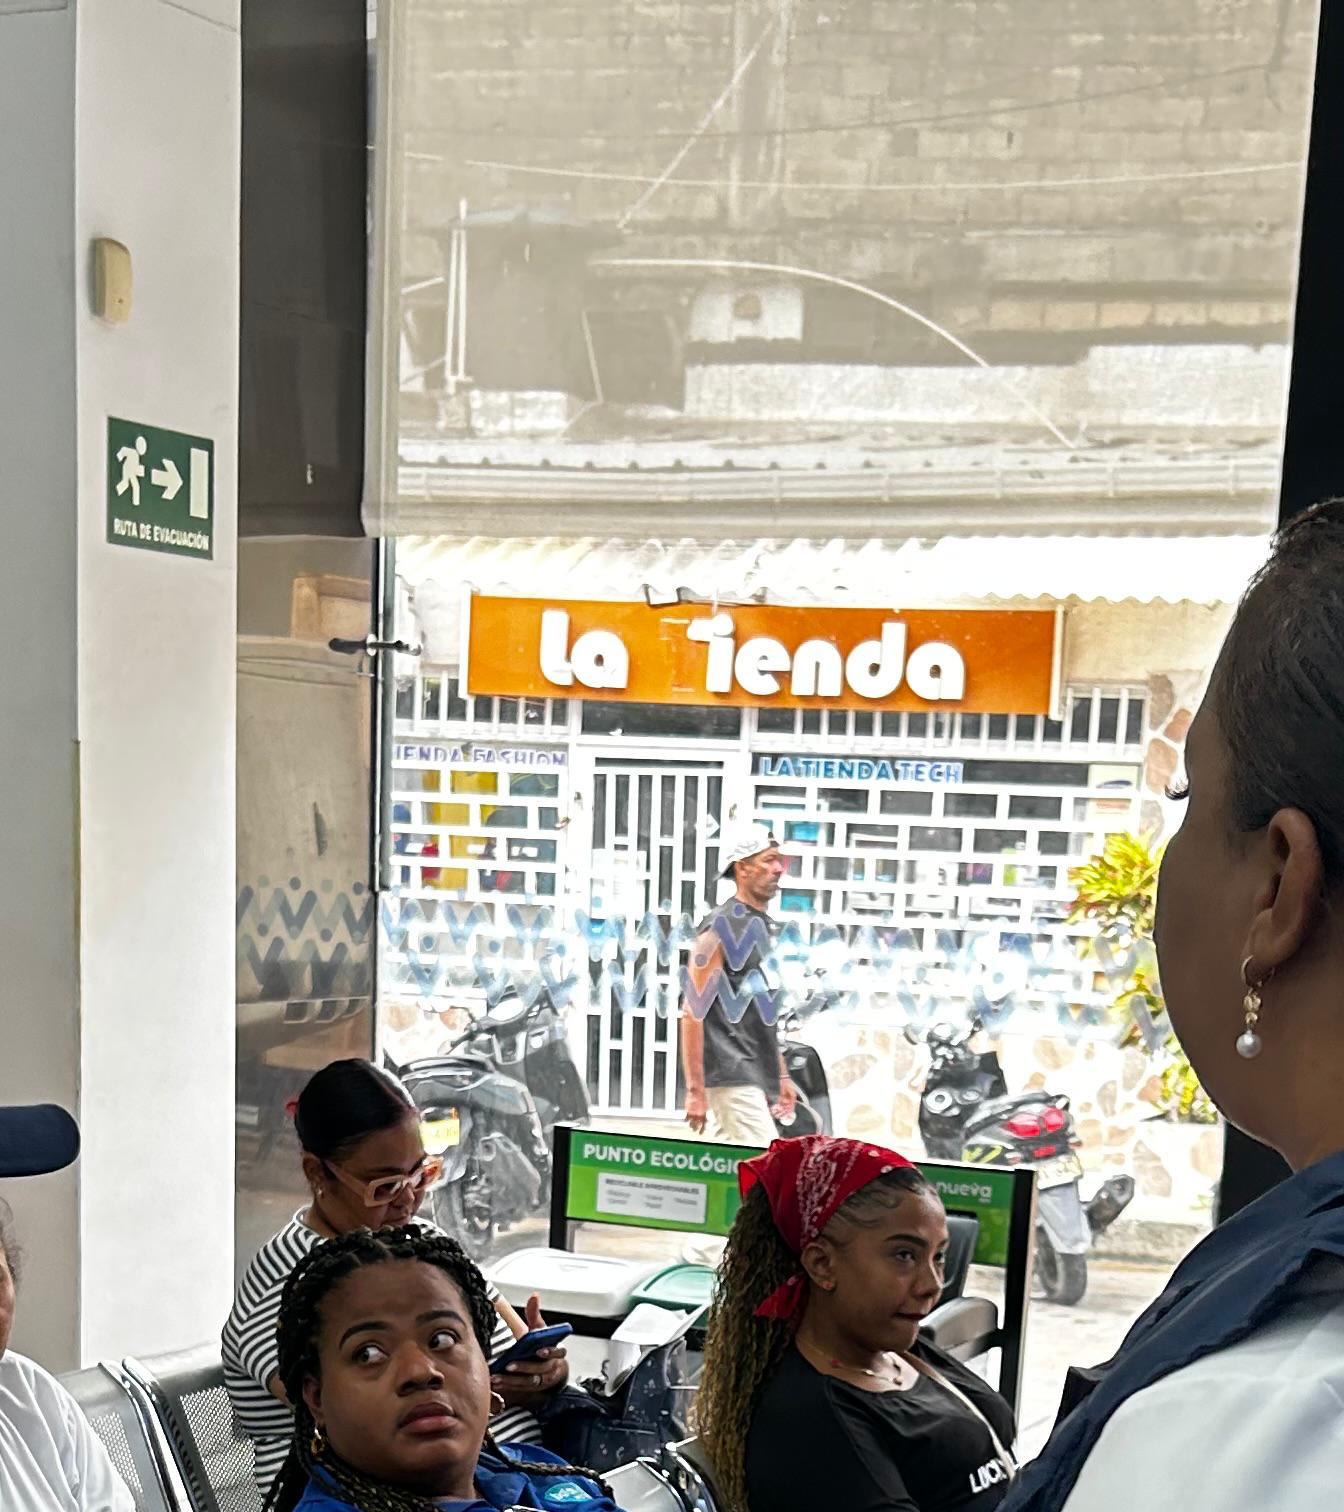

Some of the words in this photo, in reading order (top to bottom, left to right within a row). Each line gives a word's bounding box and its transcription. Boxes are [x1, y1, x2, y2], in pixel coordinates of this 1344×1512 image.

[540, 608, 629, 689] La
[760, 755, 797, 777] LA
[801, 757, 895, 781] TIENDA
[899, 761, 963, 783] TECH
[583, 1143, 646, 1165] PUNTO
[651, 1150, 739, 1175] ECOLÓGI
